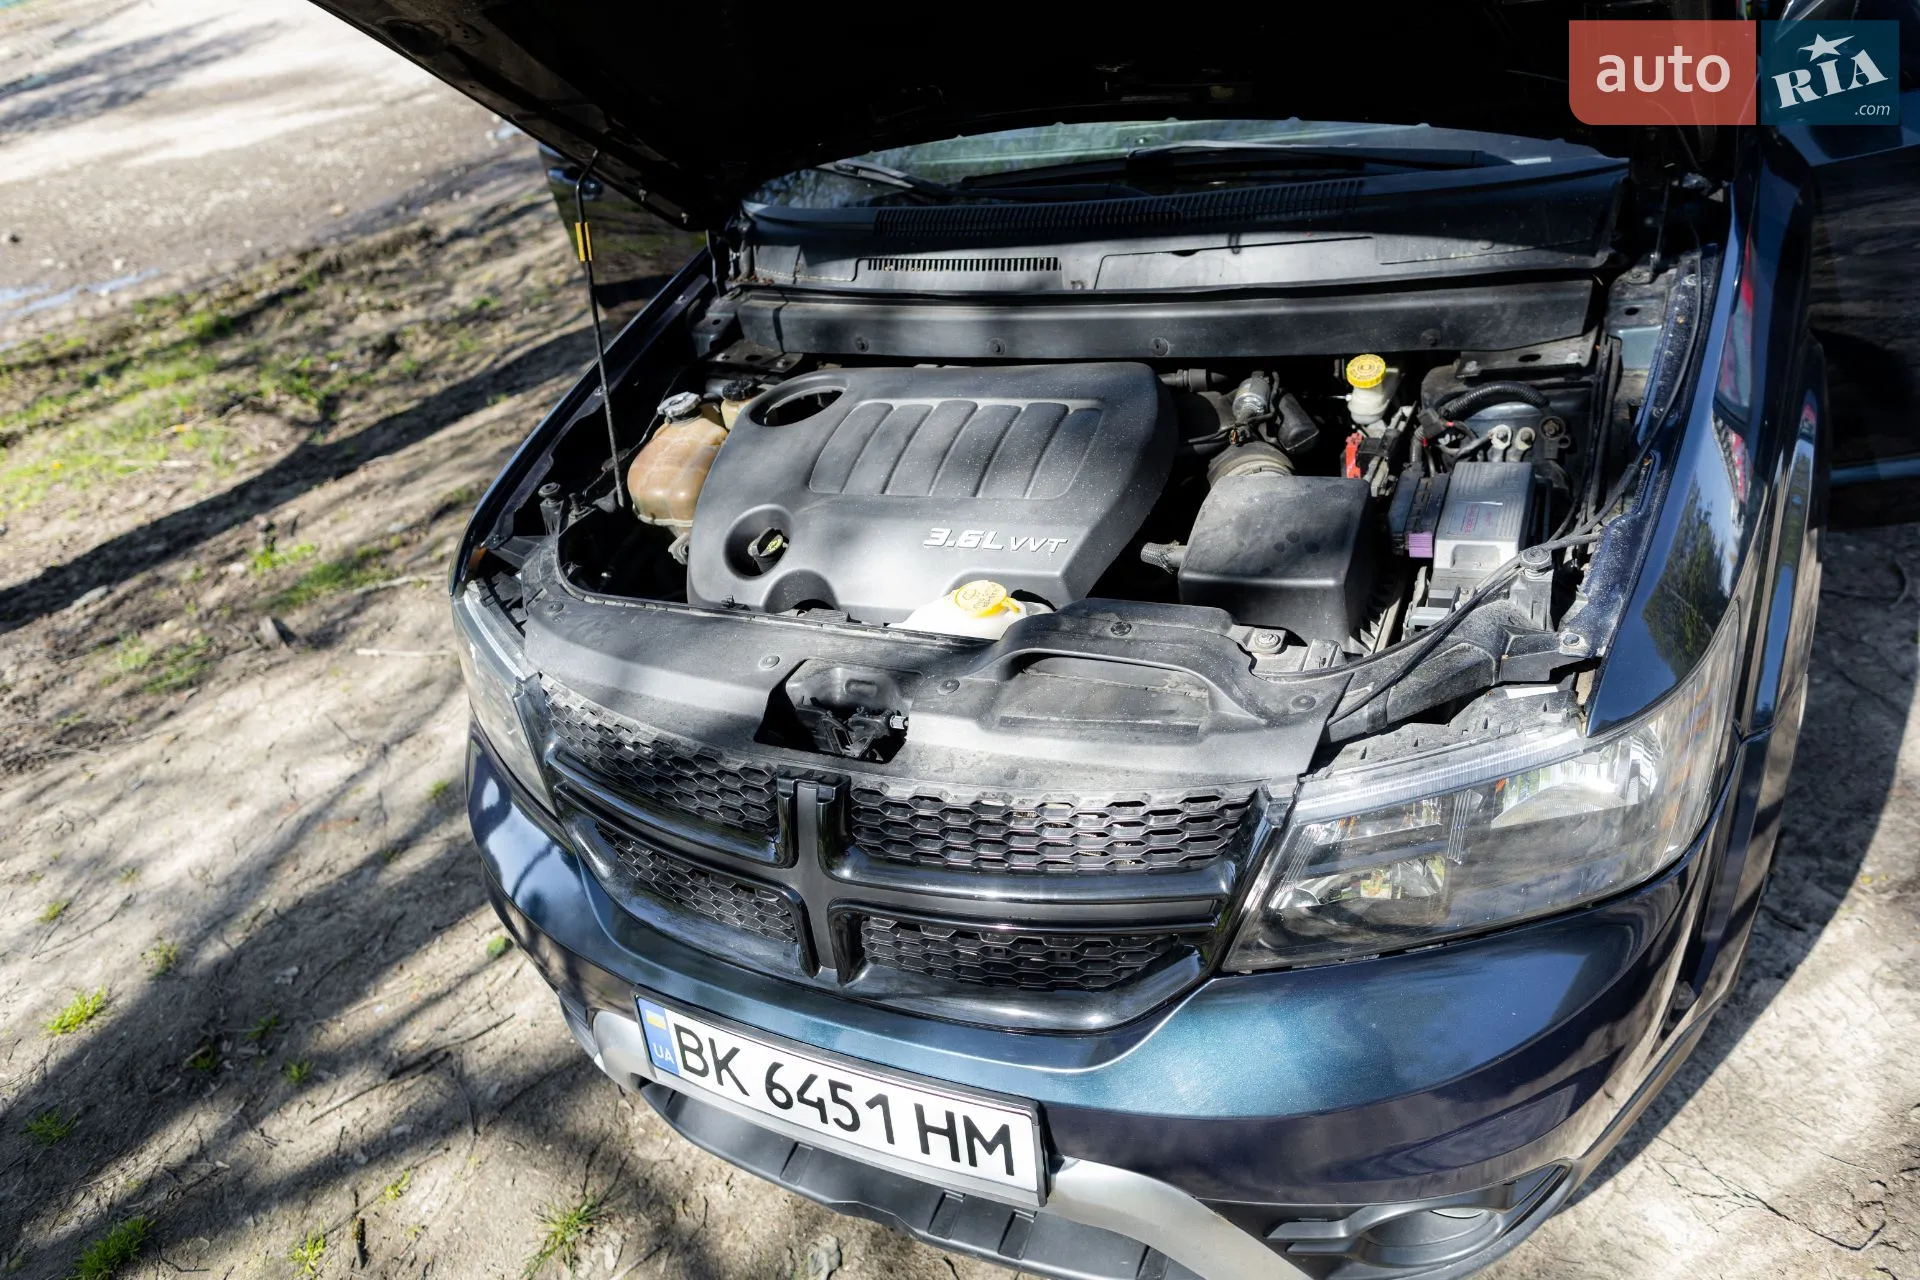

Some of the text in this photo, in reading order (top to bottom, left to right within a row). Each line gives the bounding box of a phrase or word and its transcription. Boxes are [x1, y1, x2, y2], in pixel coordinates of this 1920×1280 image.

[923, 527, 1069, 553] 3.6L VVT
[652, 1042, 675, 1065] UA
[673, 1022, 1015, 1177] BK 6451 HM
